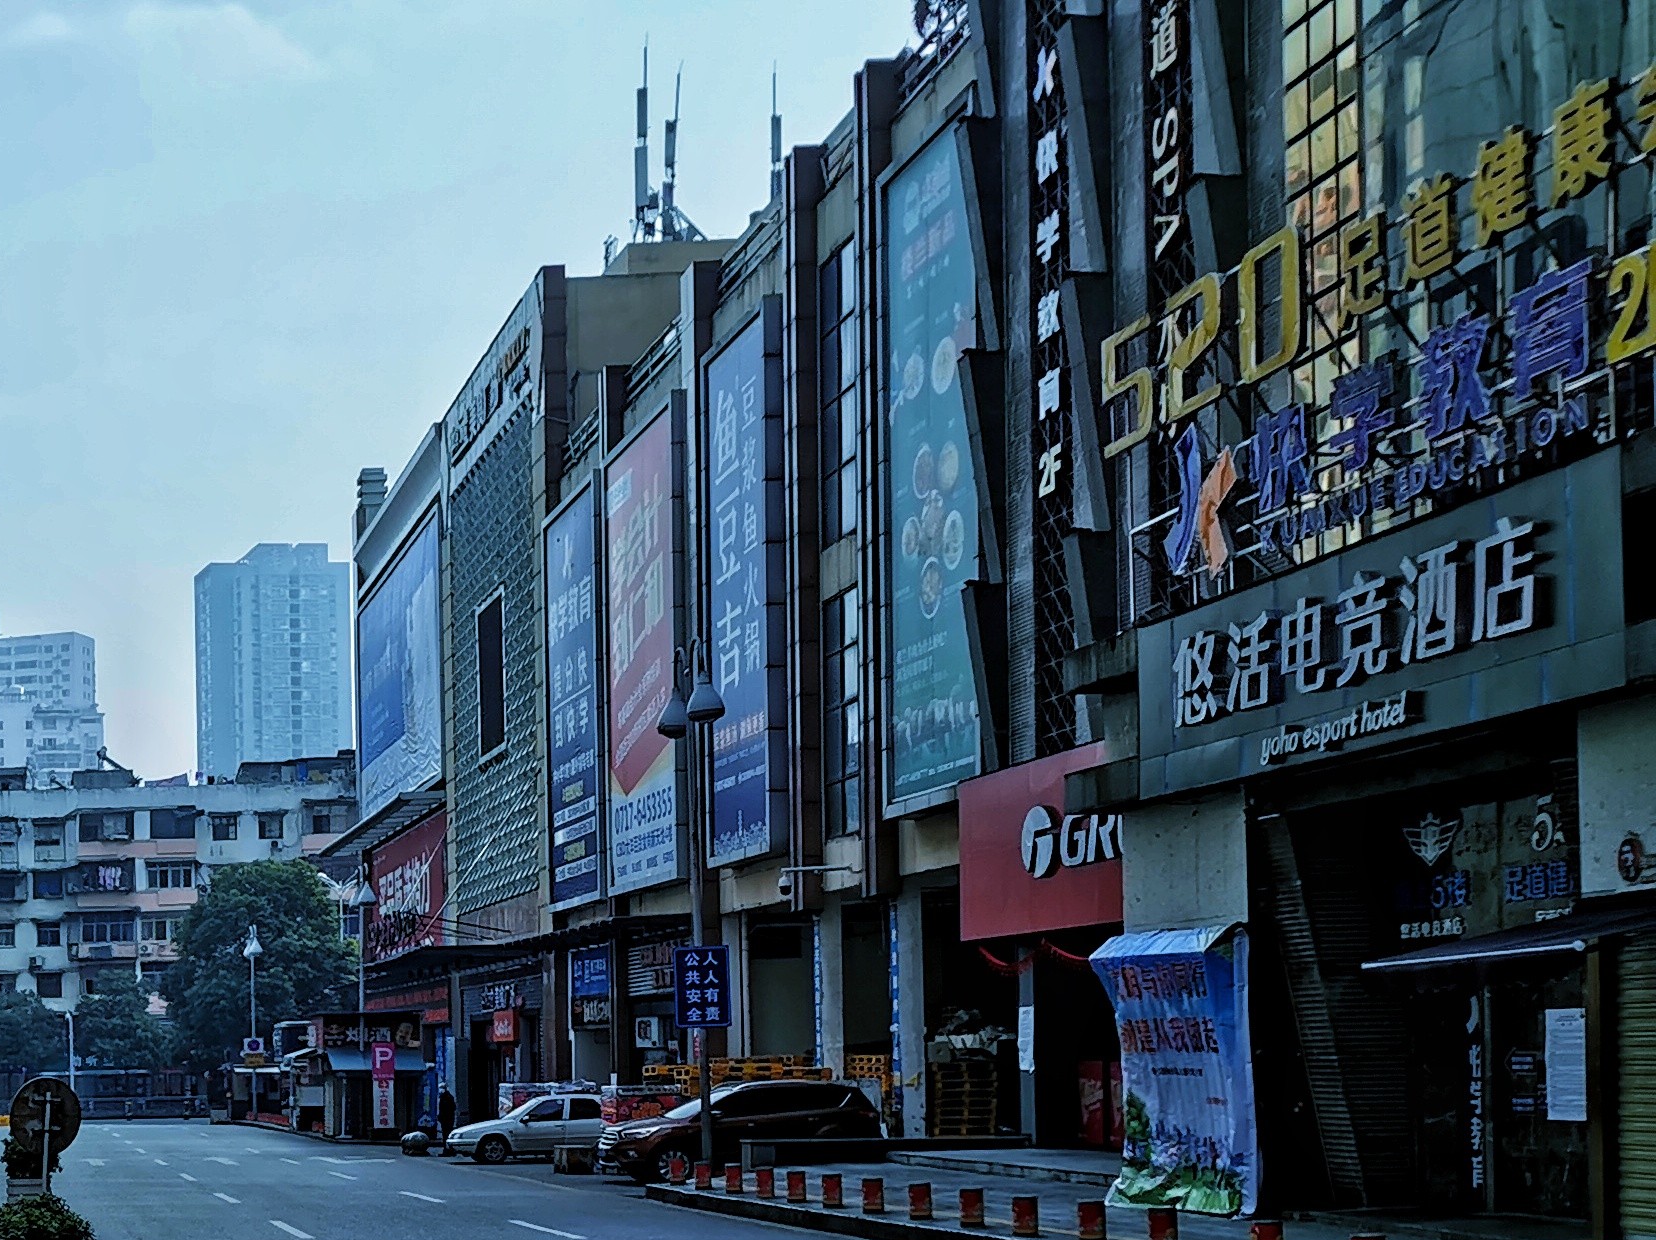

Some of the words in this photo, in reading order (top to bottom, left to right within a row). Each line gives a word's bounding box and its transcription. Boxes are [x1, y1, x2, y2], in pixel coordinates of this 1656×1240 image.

[1152, 106, 1181, 262] SPA
[1102, 224, 1301, 459] 520
[1394, 392, 1589, 503] EDUCATION
[1171, 516, 1537, 729] 悠活电竞酒店
[1261, 722, 1298, 766] yoho
[1302, 708, 1358, 755] esport
[1360, 690, 1407, 738] hotel
[684, 952, 702, 1023] 公共安全
[702, 951, 720, 1023] 人人有责
[374, 1047, 393, 1069] P
